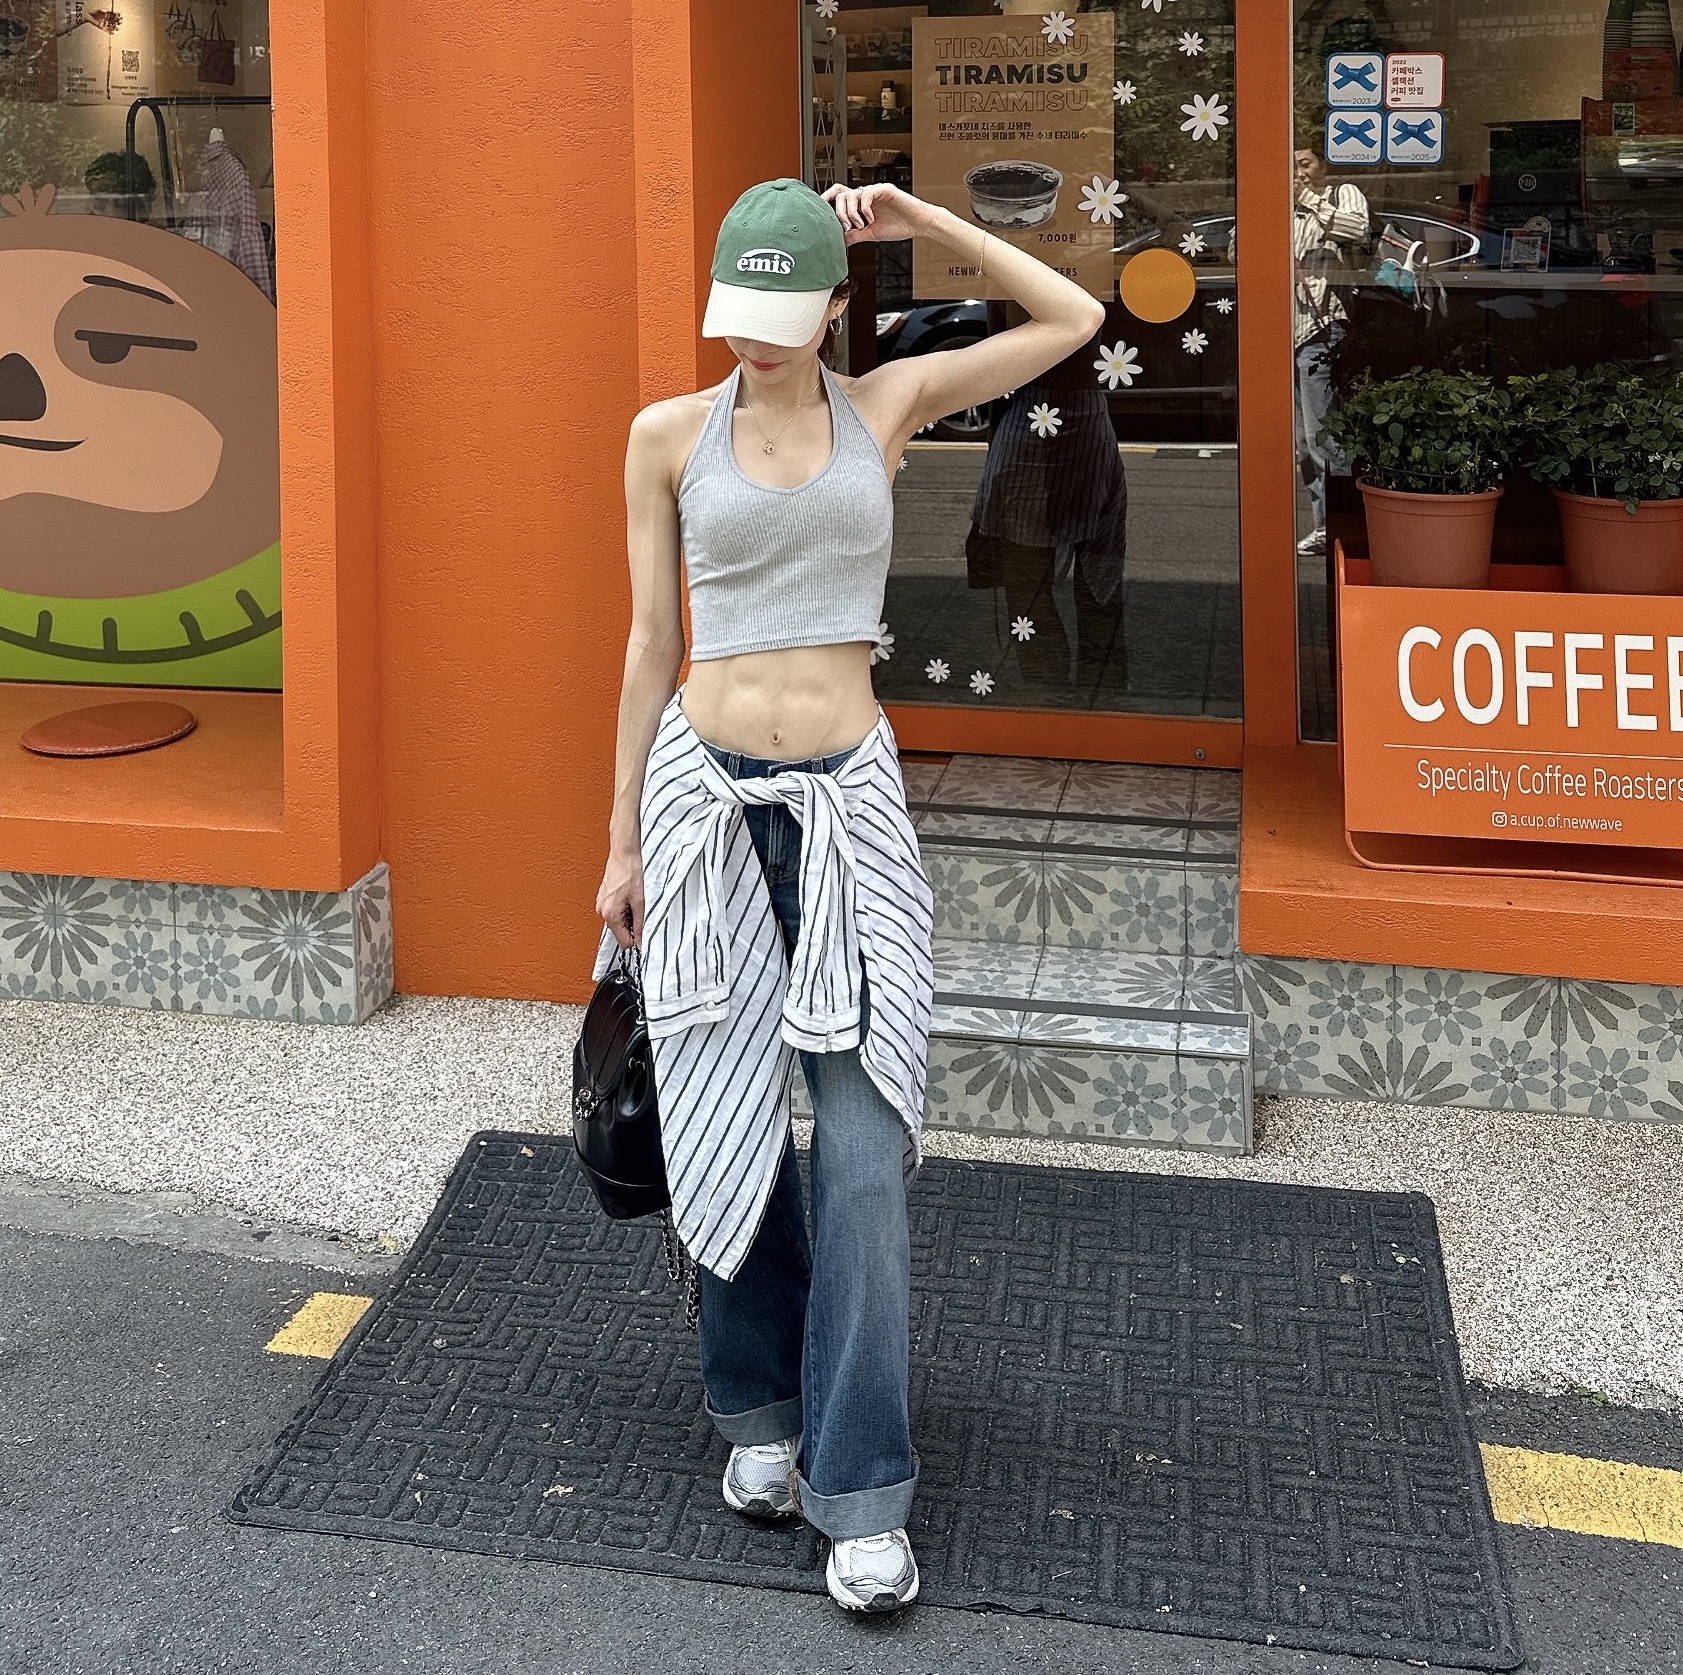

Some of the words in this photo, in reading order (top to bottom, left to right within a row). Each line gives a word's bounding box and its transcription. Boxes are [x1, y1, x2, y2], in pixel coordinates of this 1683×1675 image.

[75, 0, 85, 24] lass
[935, 35, 1089, 59] TIRAMISU
[935, 63, 1089, 85] TIRAMISU
[1391, 67, 1423, 75] 카페박스
[1391, 86, 1406, 95] 커피
[1408, 86, 1424, 95] 맛집
[935, 90, 1089, 113] TIRAMISU
[938, 122, 979, 131] 마스카포네
[981, 122, 1005, 131] 치즈를
[1007, 121, 1032, 131] 사용한
[1018, 131, 1034, 141] 가진
[1037, 233, 1077, 244] 7,000원
[736, 254, 793, 275] emis
[1417, 759, 1511, 801] Specialty
[1517, 764, 1587, 797] Coffee
[1510, 812, 1623, 831] a.cup.of.newwave
